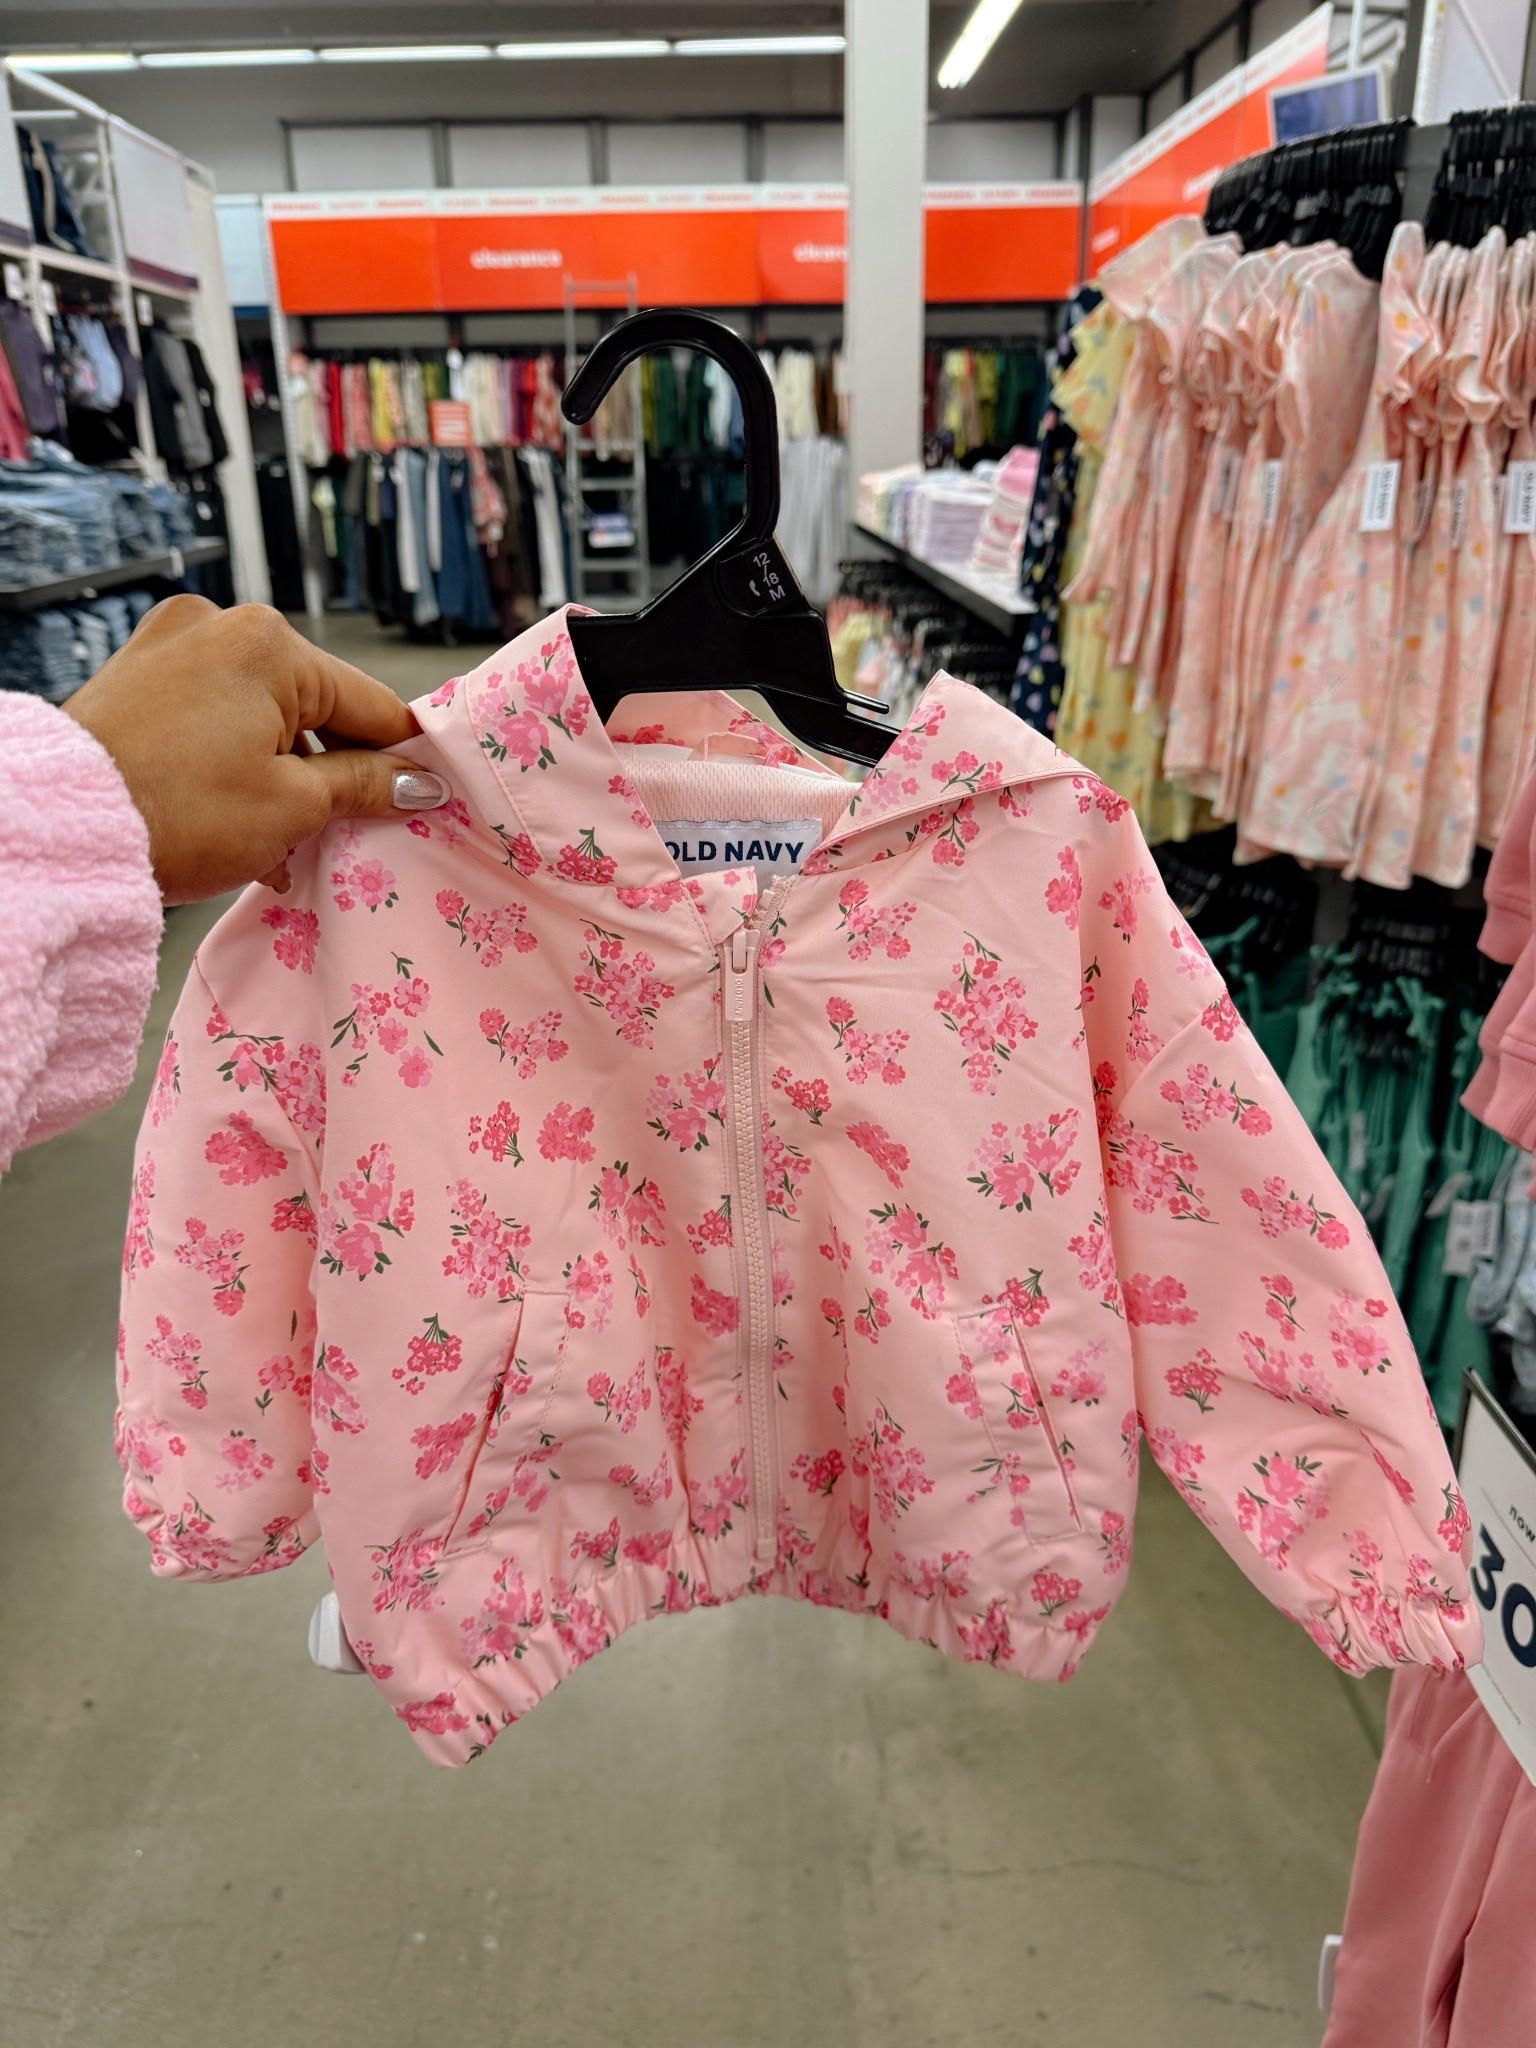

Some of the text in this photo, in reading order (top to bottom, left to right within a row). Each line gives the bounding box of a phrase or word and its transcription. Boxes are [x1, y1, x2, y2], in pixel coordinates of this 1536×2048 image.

[471, 247, 563, 270] clearance
[753, 552, 771, 568] 12
[762, 572, 780, 588] 18
[768, 584, 786, 602] M
[724, 840, 804, 863] NAVY
[1508, 1503, 1536, 1544] now
